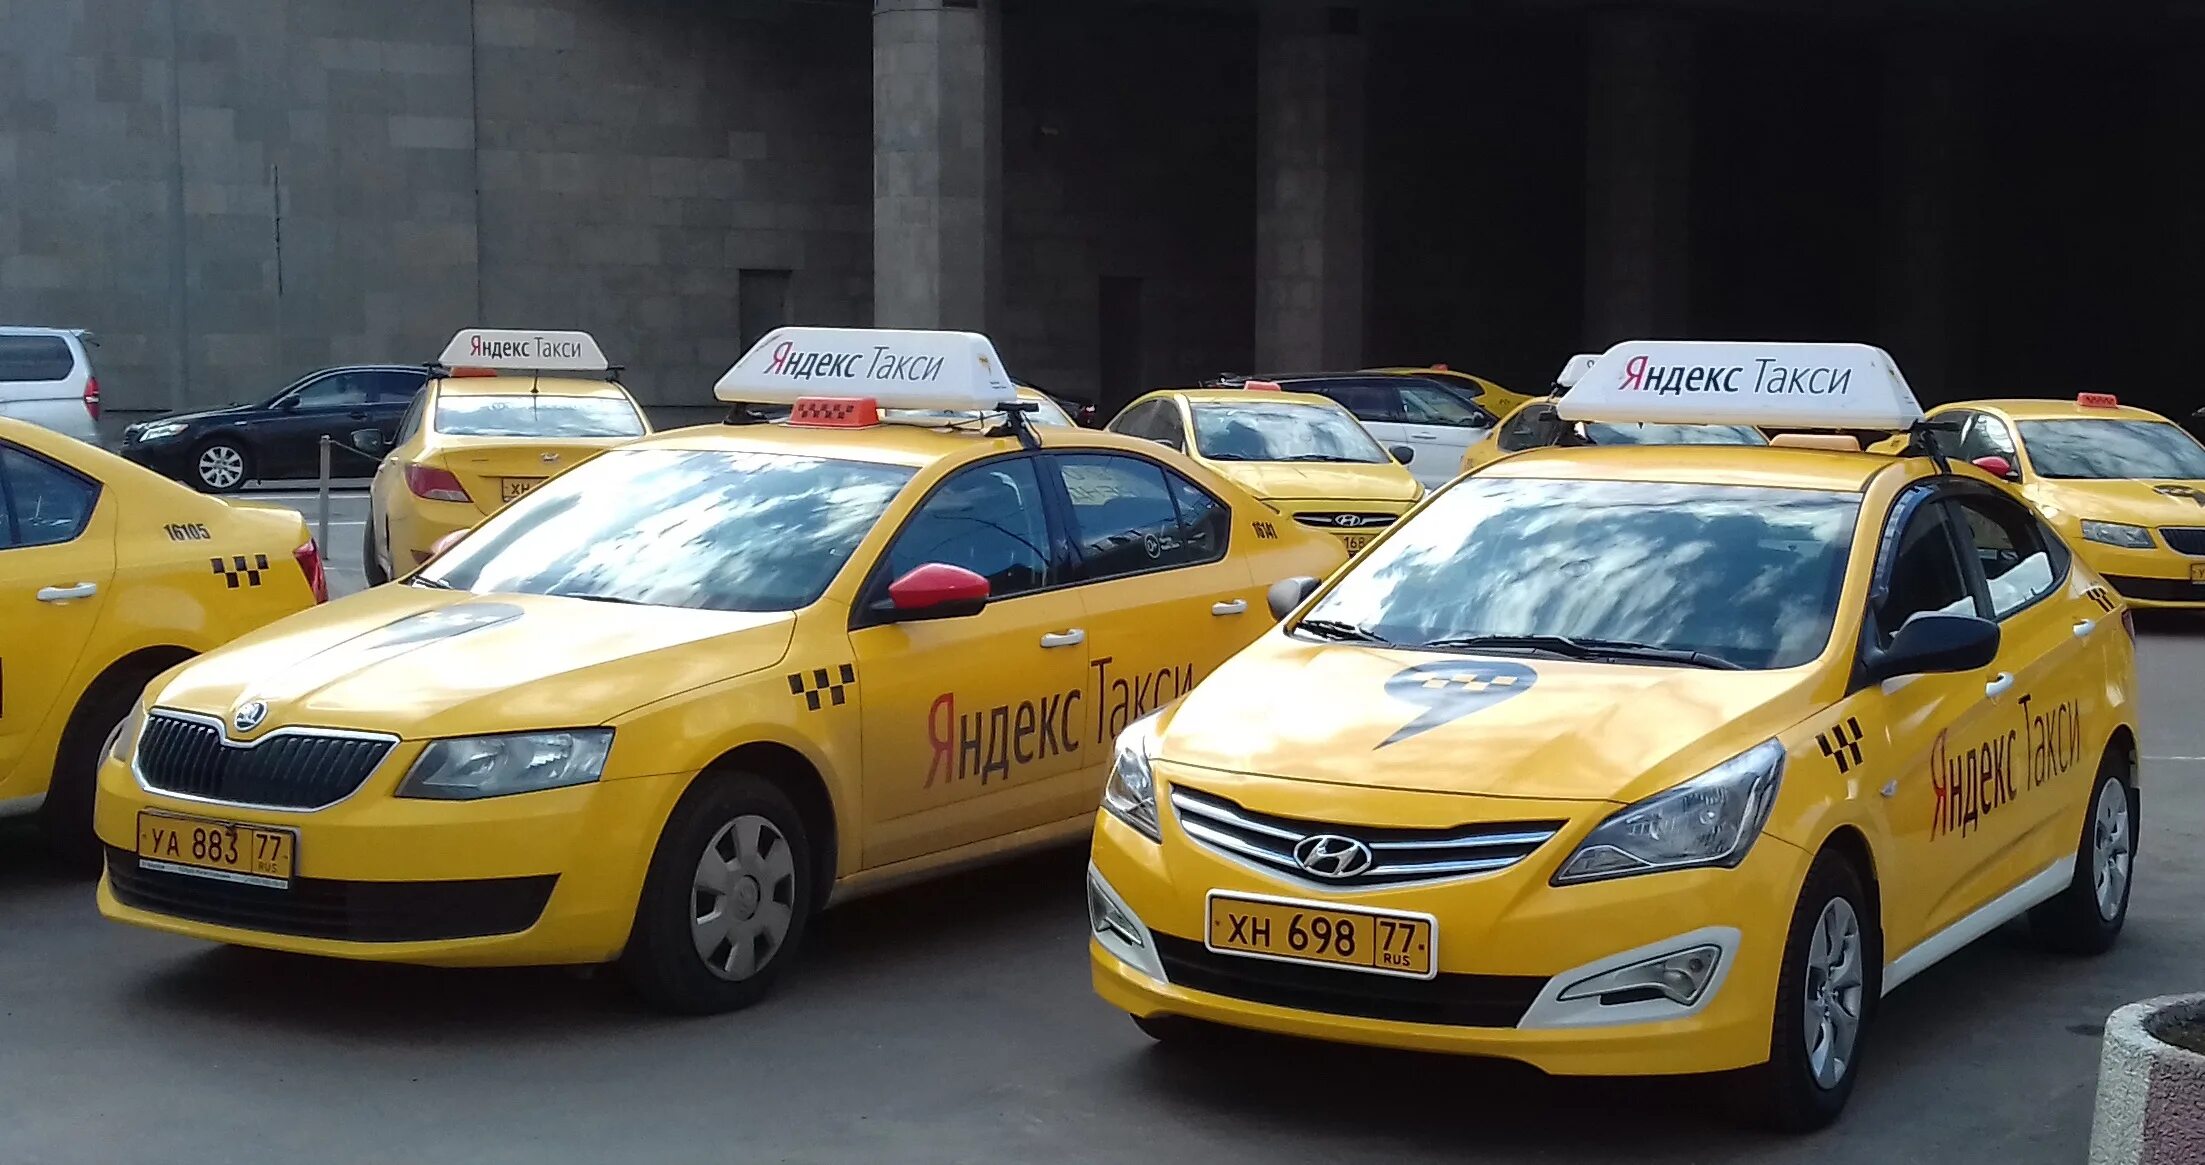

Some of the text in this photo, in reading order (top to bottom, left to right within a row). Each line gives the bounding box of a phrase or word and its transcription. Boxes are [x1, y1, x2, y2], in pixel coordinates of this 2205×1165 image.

[470, 335, 582, 359] Яндекс Такси
[764, 341, 944, 381] Яндекс Такси
[1617, 355, 1853, 396] Яндекс Такси
[163, 523, 211, 541] 16105
[923, 656, 1193, 789] Яндекс Такси
[1930, 693, 2080, 842] Яндекс Такси
[151, 827, 281, 865] УА 883 77
[258, 862, 278, 873] RUS
[1228, 914, 1416, 957] ХН 698 77
[1384, 953, 1410, 966] RUS
